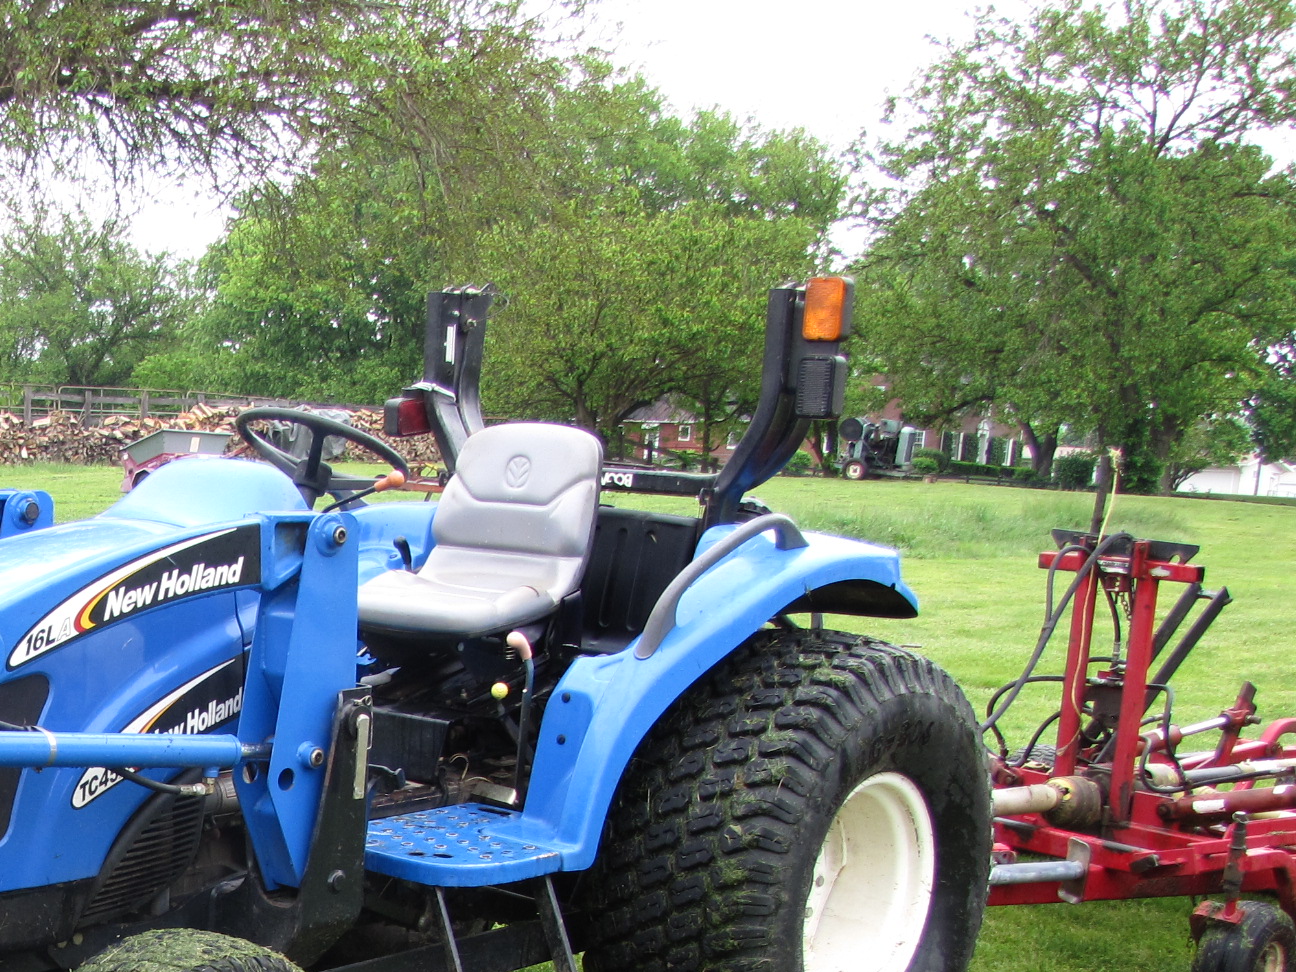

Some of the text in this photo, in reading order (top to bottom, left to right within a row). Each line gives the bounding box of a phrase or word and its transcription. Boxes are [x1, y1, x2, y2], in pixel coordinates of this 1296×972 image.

[25, 556, 245, 656] 16LA New Holland
[186, 686, 243, 735] Holland
